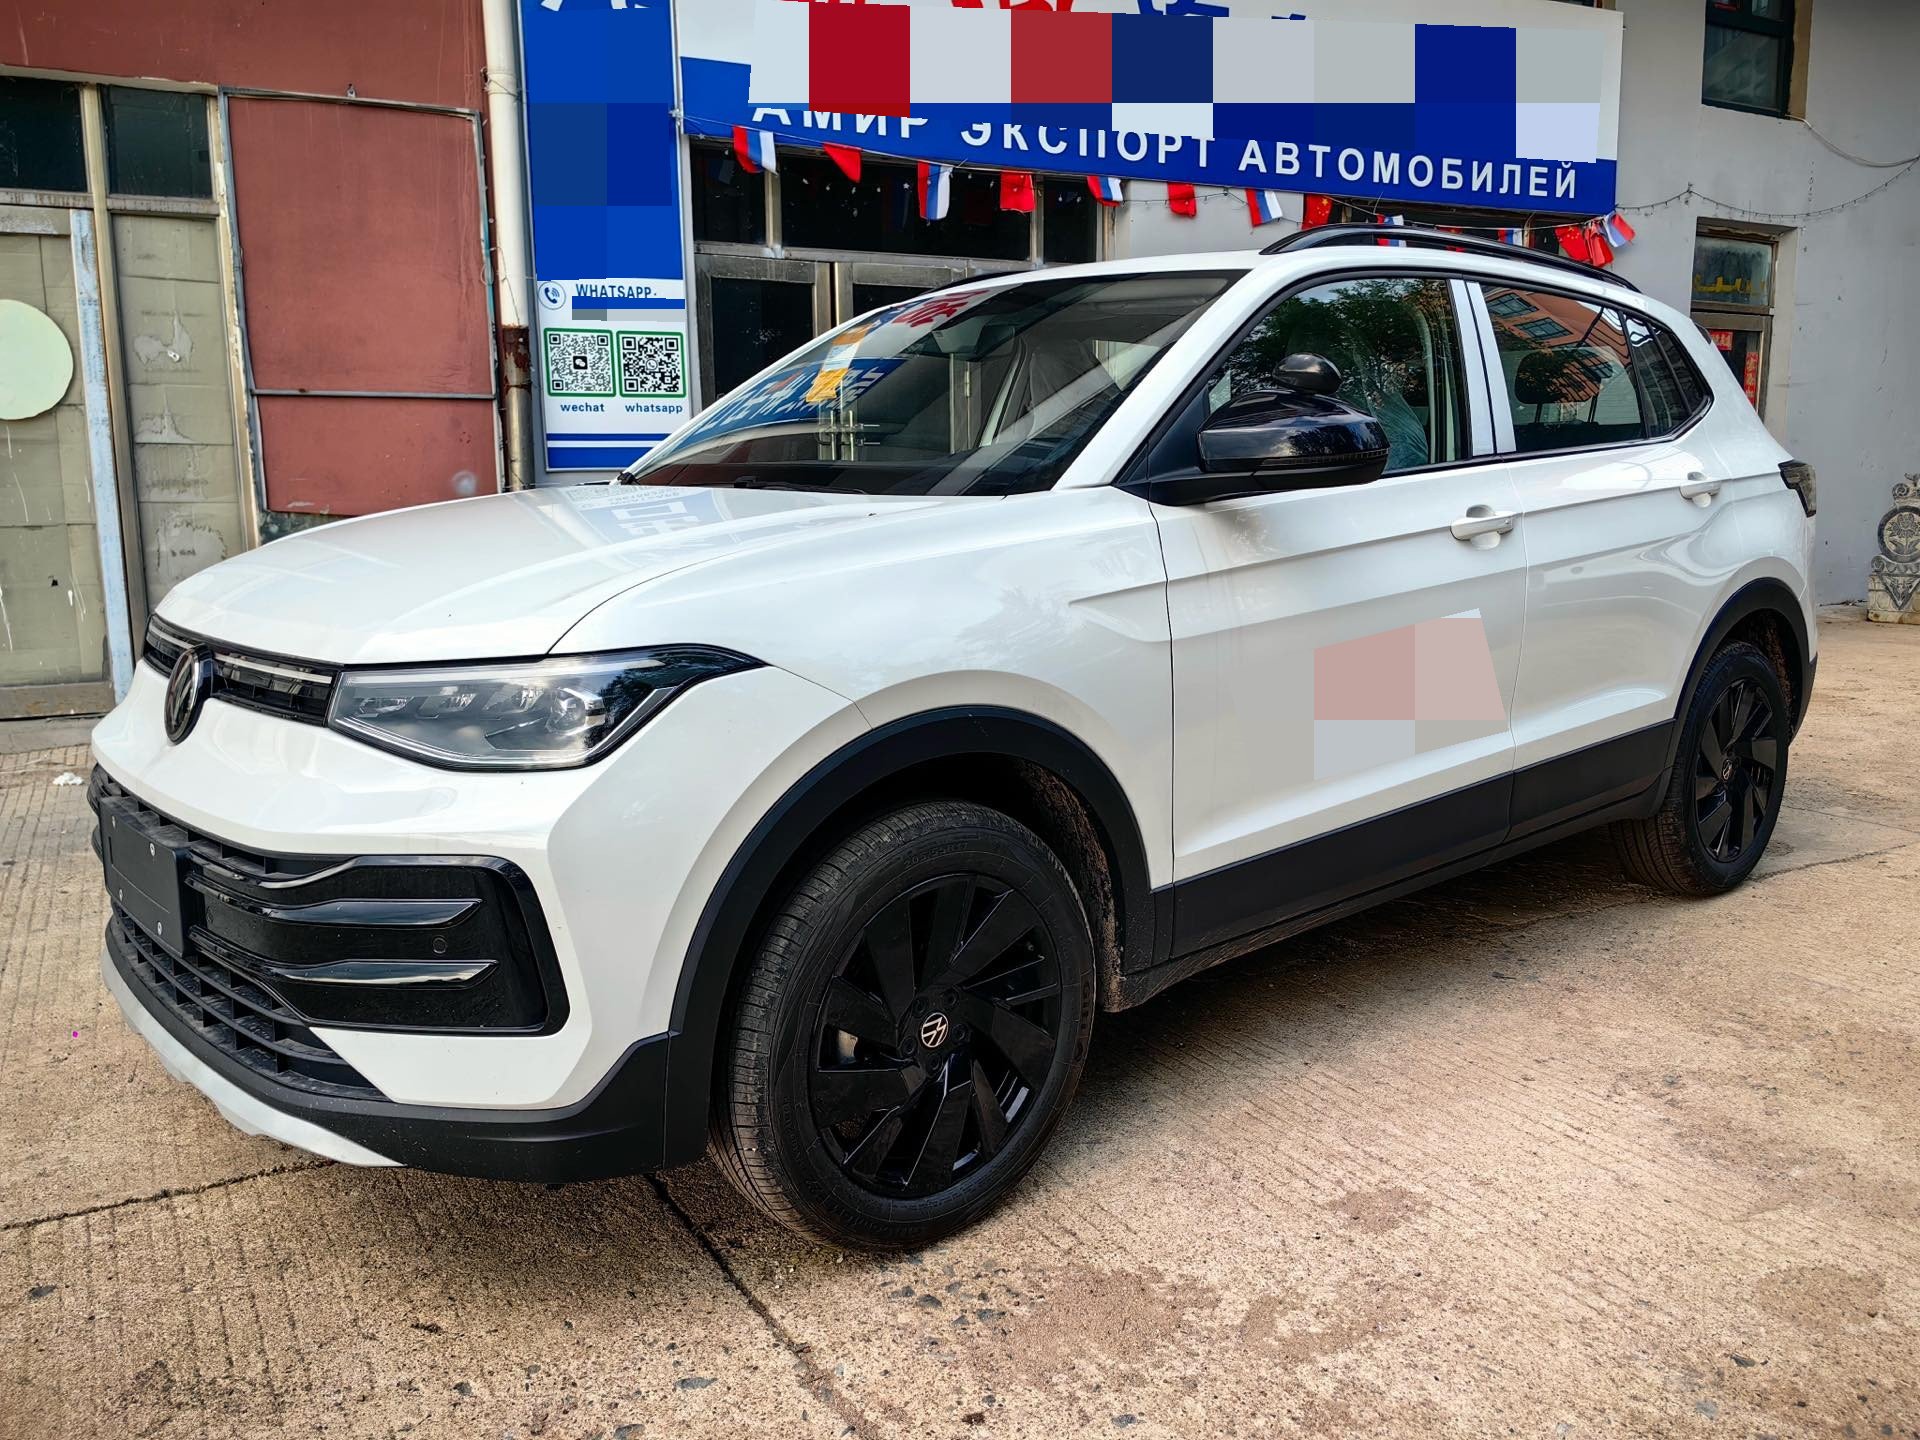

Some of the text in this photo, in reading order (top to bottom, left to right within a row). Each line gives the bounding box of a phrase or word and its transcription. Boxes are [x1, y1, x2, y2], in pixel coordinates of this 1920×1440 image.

[960, 122, 1216, 168] ЭКСПОРТ
[1238, 139, 1577, 199] АВТОМОБИЛЕЙ
[560, 402, 605, 412] wechat
[624, 402, 683, 414] whatsapp
